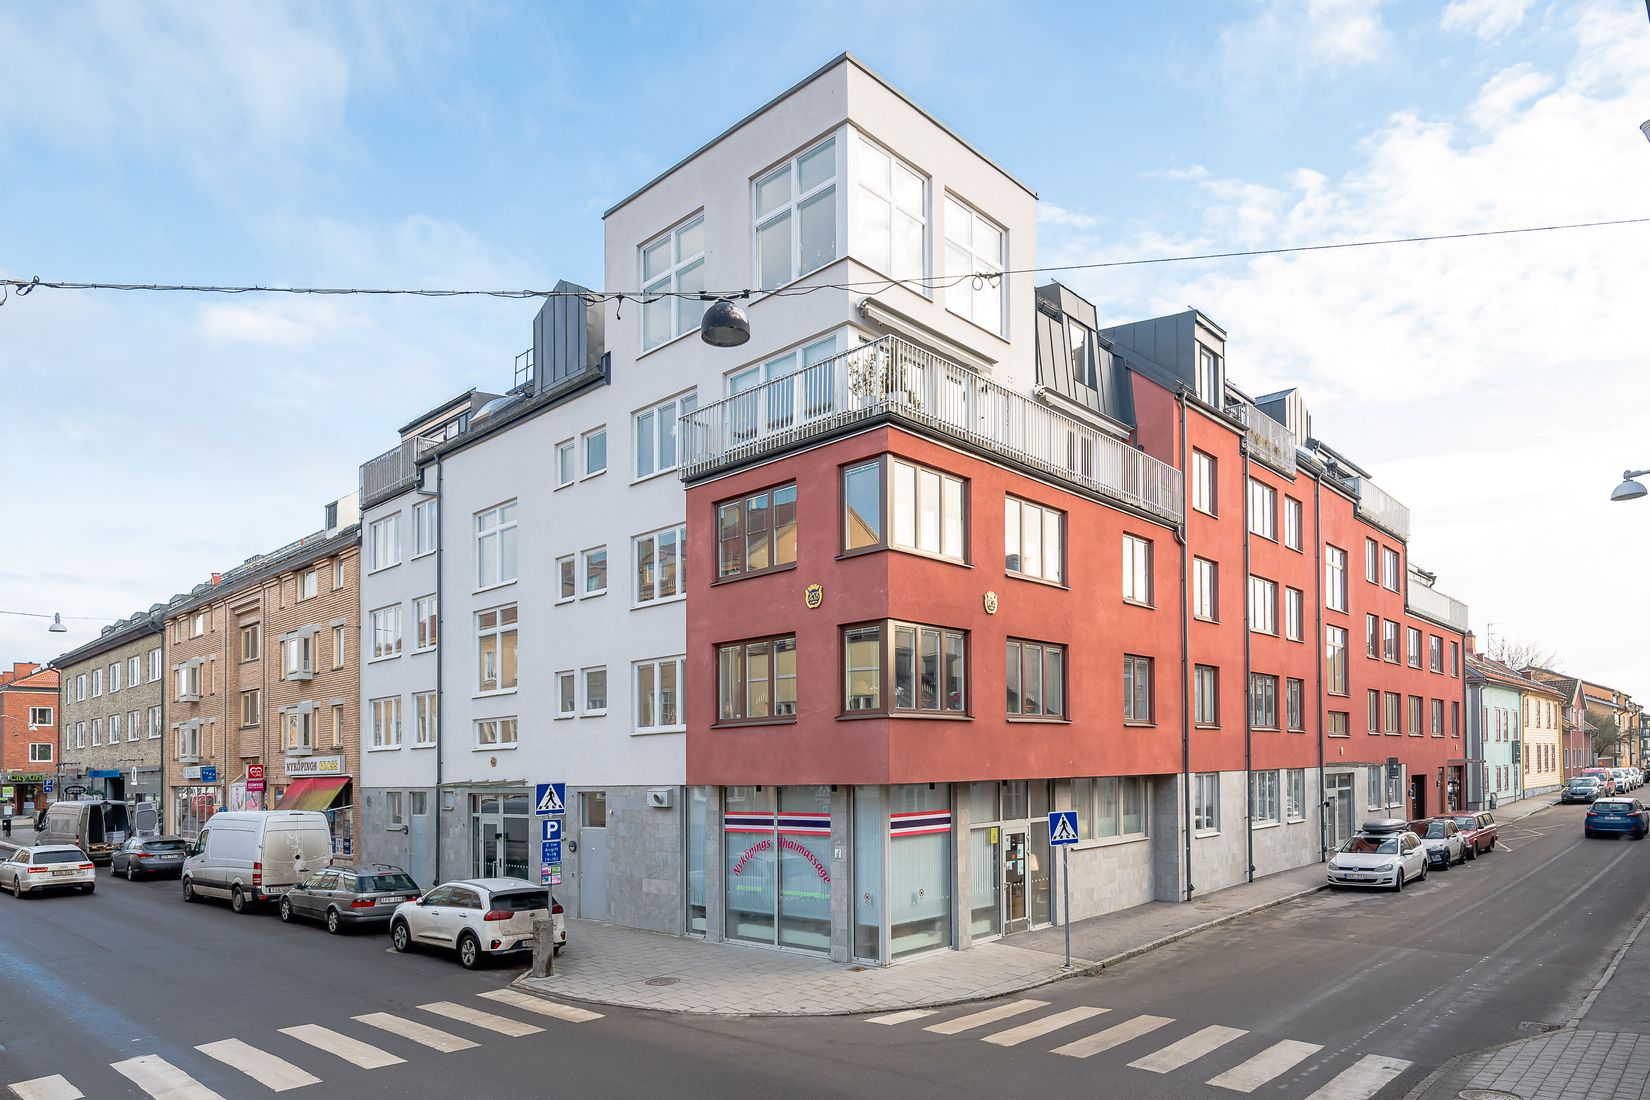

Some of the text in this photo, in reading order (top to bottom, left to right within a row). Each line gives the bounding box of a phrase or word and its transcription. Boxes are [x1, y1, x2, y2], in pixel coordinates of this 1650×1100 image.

[286, 760, 338, 772] NYKÖPINGS GROSS
[11, 775, 27, 783] City
[547, 822, 558, 838] P
[733, 839, 771, 877] Nyköpings
